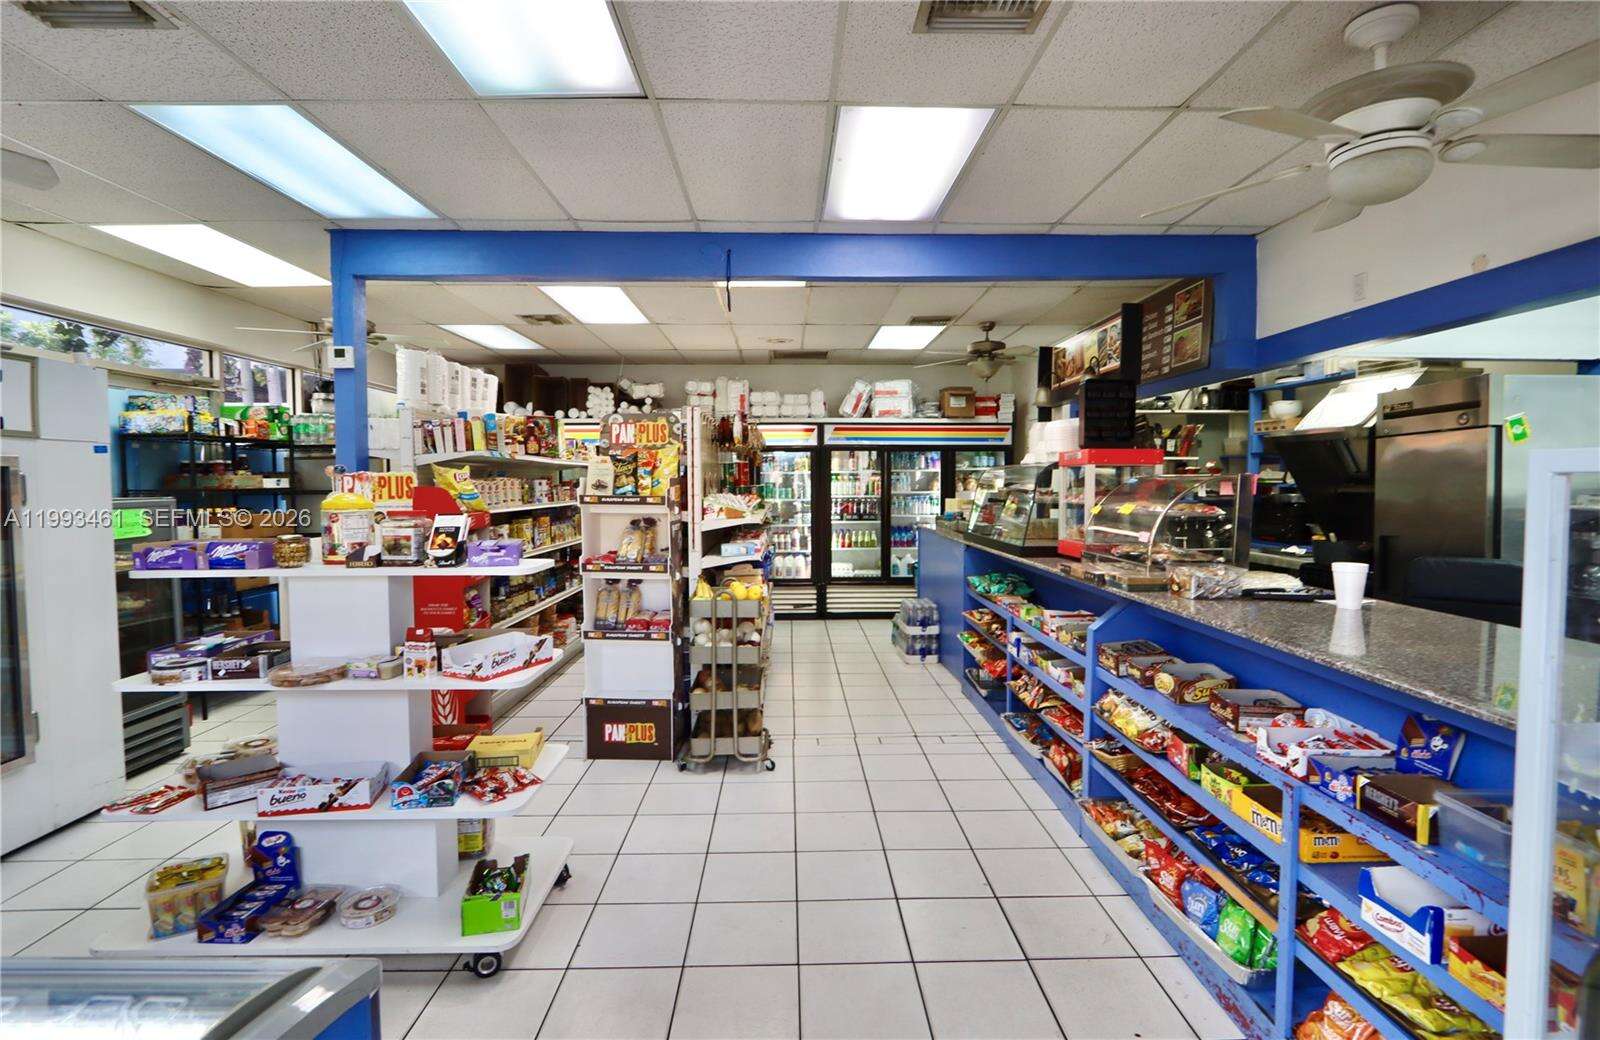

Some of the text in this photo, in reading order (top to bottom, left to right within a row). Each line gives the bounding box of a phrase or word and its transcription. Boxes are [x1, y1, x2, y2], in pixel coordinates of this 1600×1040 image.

[611, 423, 668, 444] PAN PLUS
[378, 475, 414, 500] PLUS
[208, 542, 249, 558] Milka
[491, 652, 518, 669] bueno
[605, 723, 656, 742] PAN PLUS
[269, 791, 307, 806] bueno
